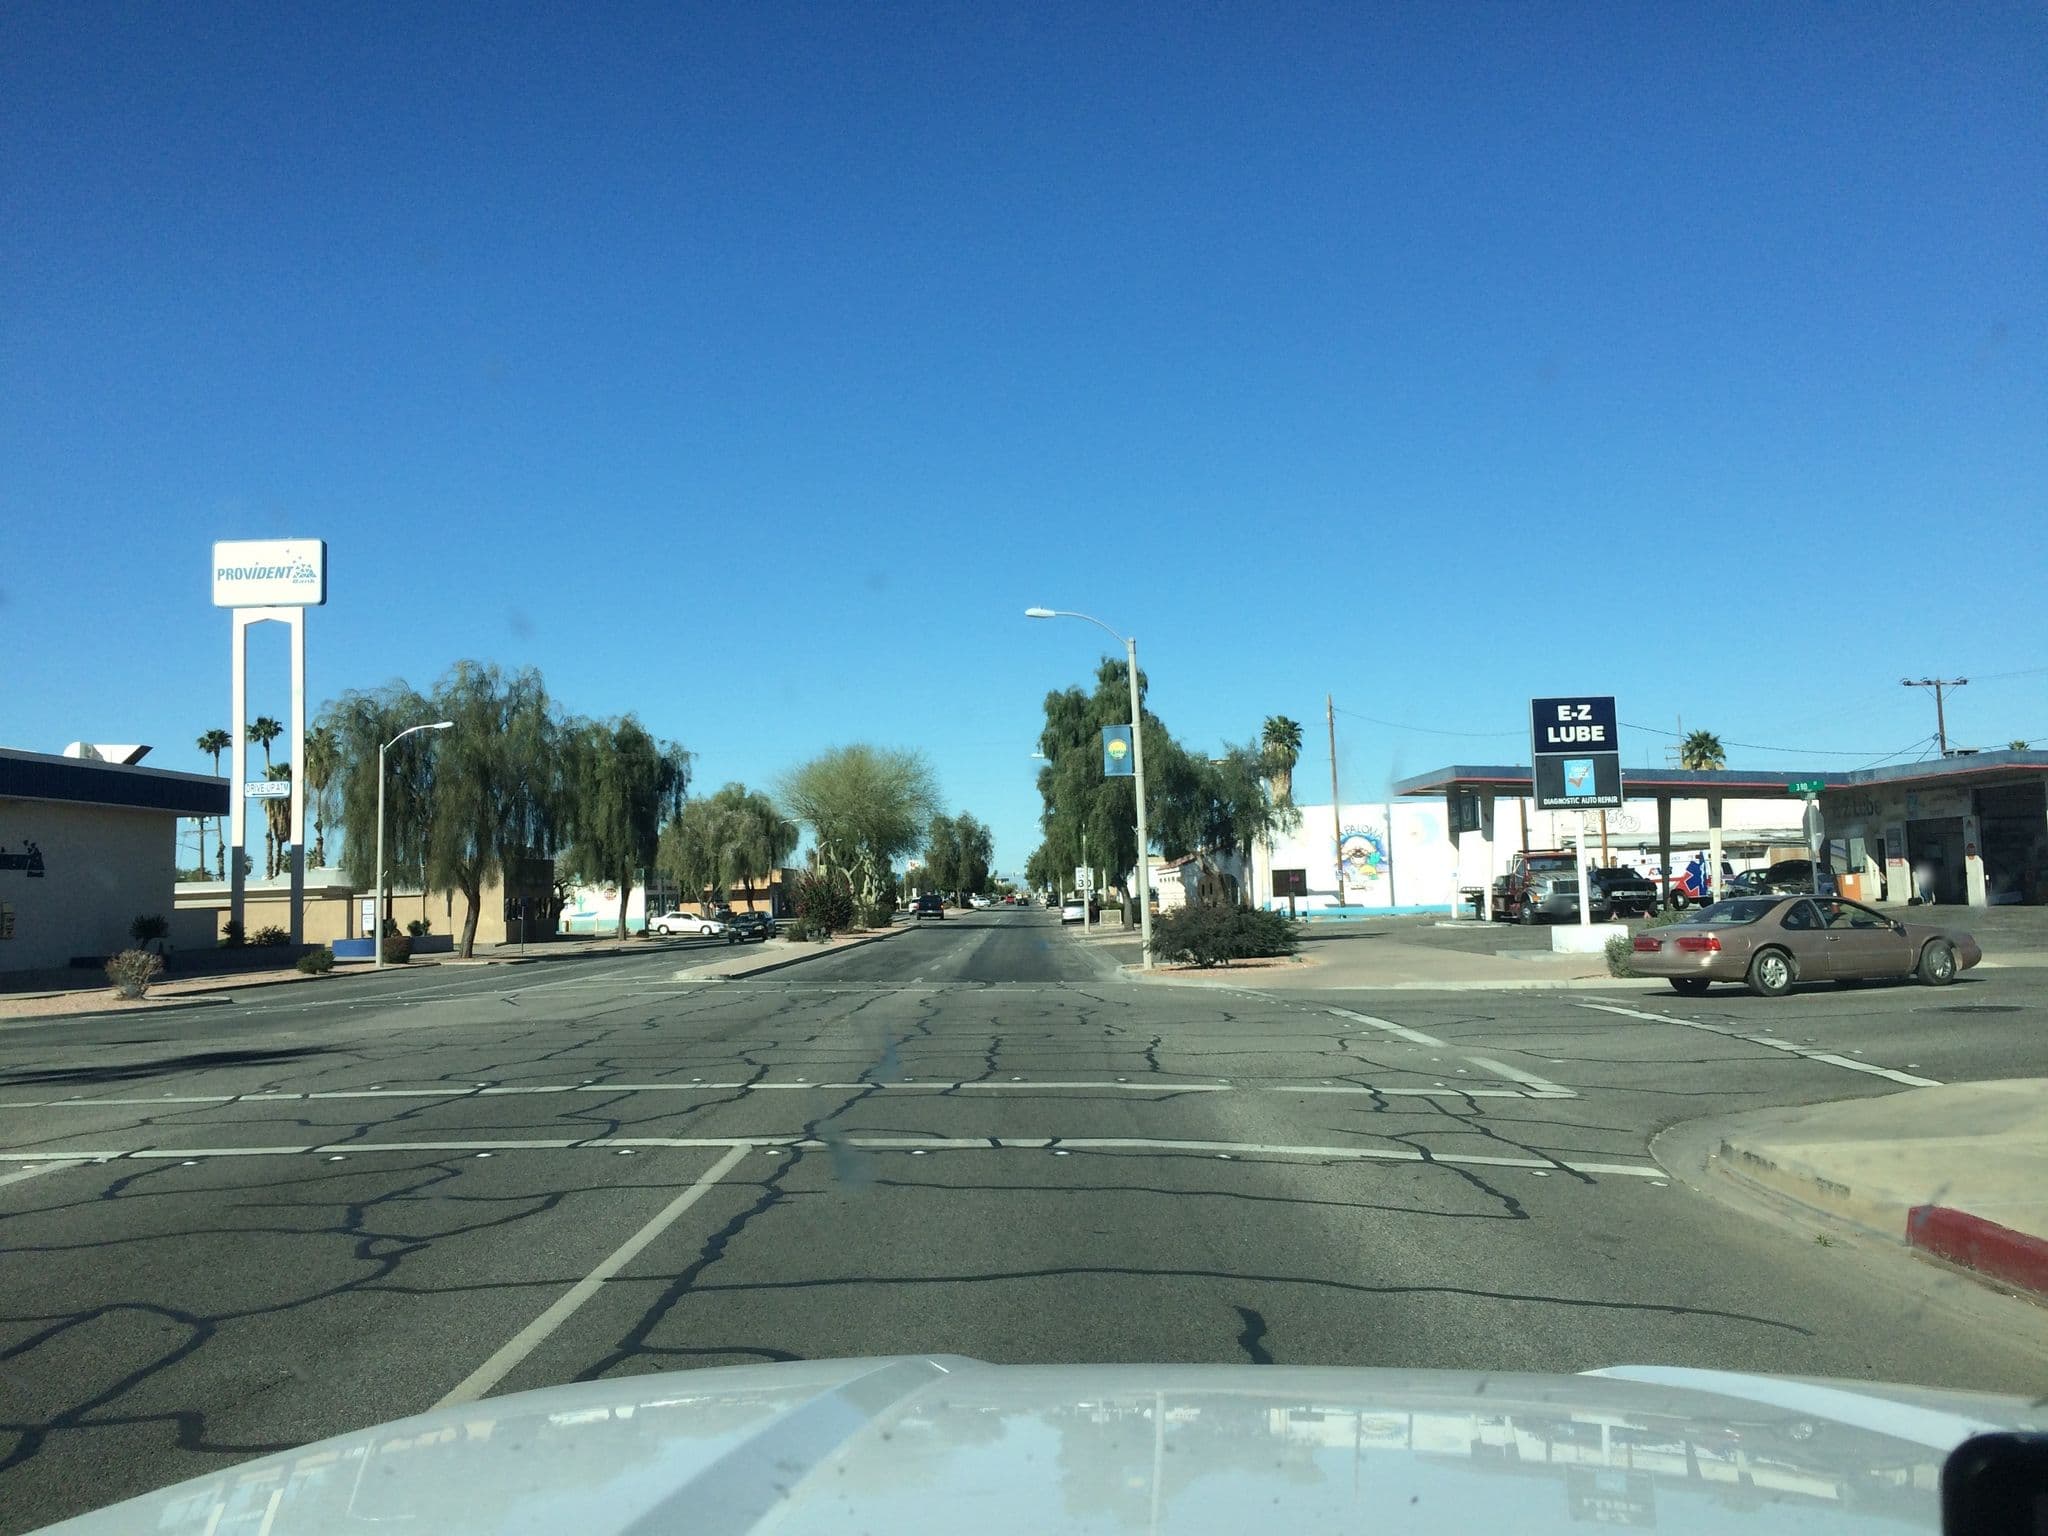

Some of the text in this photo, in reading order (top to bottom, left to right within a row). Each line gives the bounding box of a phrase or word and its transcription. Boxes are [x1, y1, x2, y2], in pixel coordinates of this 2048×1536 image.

[217, 565, 294, 581] PROVIDENT
[1557, 704, 1593, 722] E-Z
[1547, 725, 1605, 743] LUBE
[1543, 795, 1619, 806] DIAGNOSTIC AUTO REPAIR
